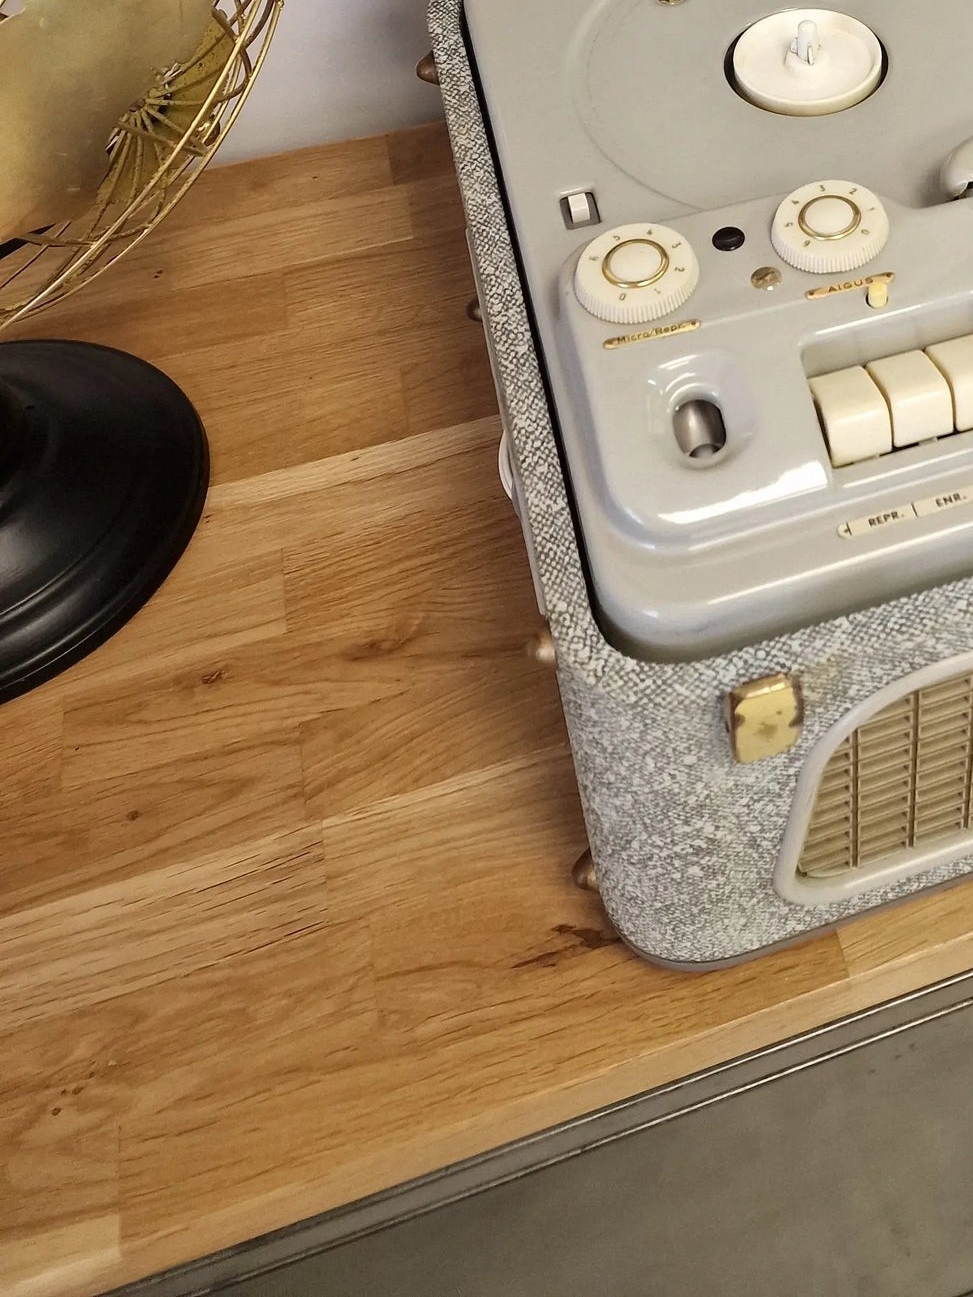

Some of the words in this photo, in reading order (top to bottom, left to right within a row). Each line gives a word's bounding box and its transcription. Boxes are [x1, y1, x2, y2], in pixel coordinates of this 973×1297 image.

[828, 277, 874, 294] AIGUS
[868, 510, 905, 528] REPR.
[935, 491, 969, 508] ENR.
